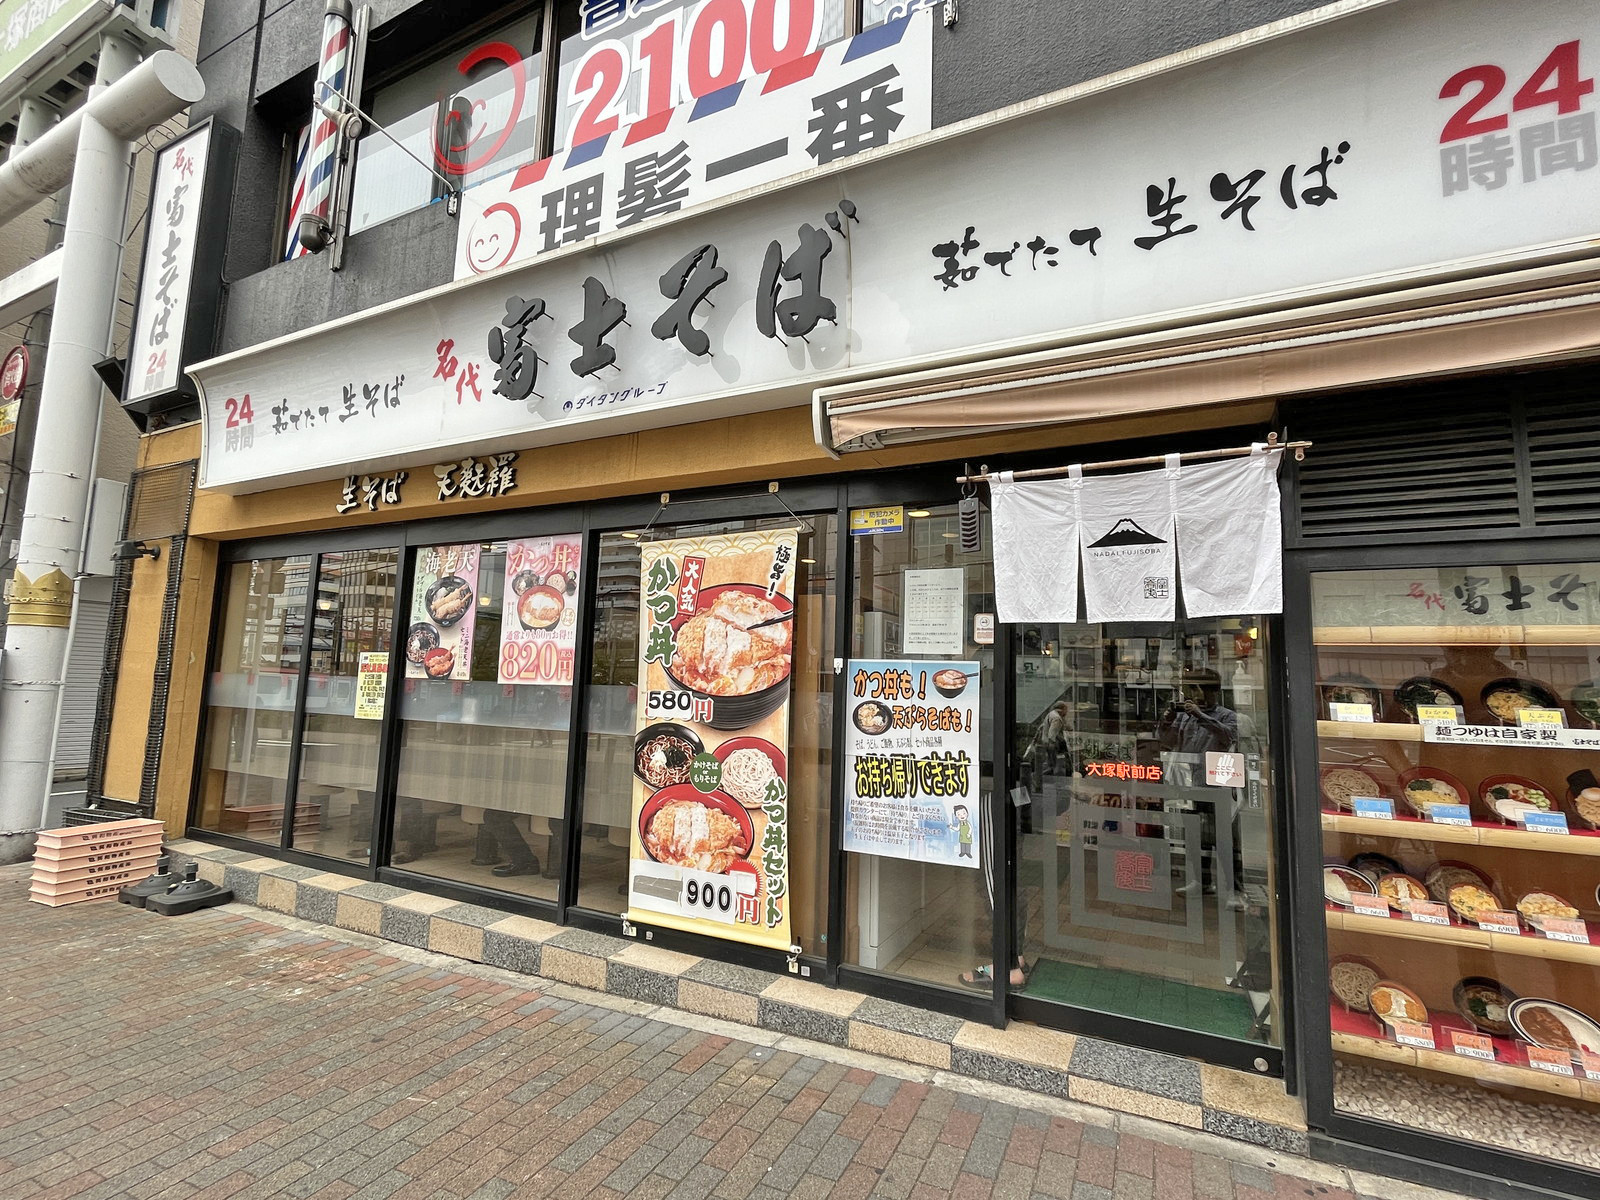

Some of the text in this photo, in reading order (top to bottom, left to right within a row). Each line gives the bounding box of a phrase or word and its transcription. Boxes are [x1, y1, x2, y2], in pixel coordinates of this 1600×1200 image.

[571, 0, 815, 148] 2100
[1438, 39, 1594, 143] 24
[173, 147, 194, 181] 名代
[1439, 111, 1598, 197] 時間
[932, 141, 1350, 290] 茹でたて 生そば
[150, 184, 189, 346] 富士そば
[433, 199, 857, 405] 名代 富士そば
[147, 350, 167, 375] 24
[225, 394, 254, 428] 24
[339, 374, 404, 423] 生そば
[576, 381, 668, 409] ダイタングループ
[225, 424, 254, 453] 時間
[336, 471, 407, 514] 生そば
[869, 509, 899, 518] 防犯カメラ
[425, 549, 475, 574] 海老天
[509, 544, 573, 575] かつ丼
[681, 561, 701, 611] 大人気
[1407, 573, 1600, 616] 名代 富士そ
[645, 556, 680, 667] かつ丼
[694, 760, 719, 770] かけそば
[694, 774, 718, 783] もりそば
[854, 750, 971, 798] お持ち帰りできます
[1087, 762, 1161, 781] 大塚駅前店
[762, 778, 786, 927] かつ丼セット
